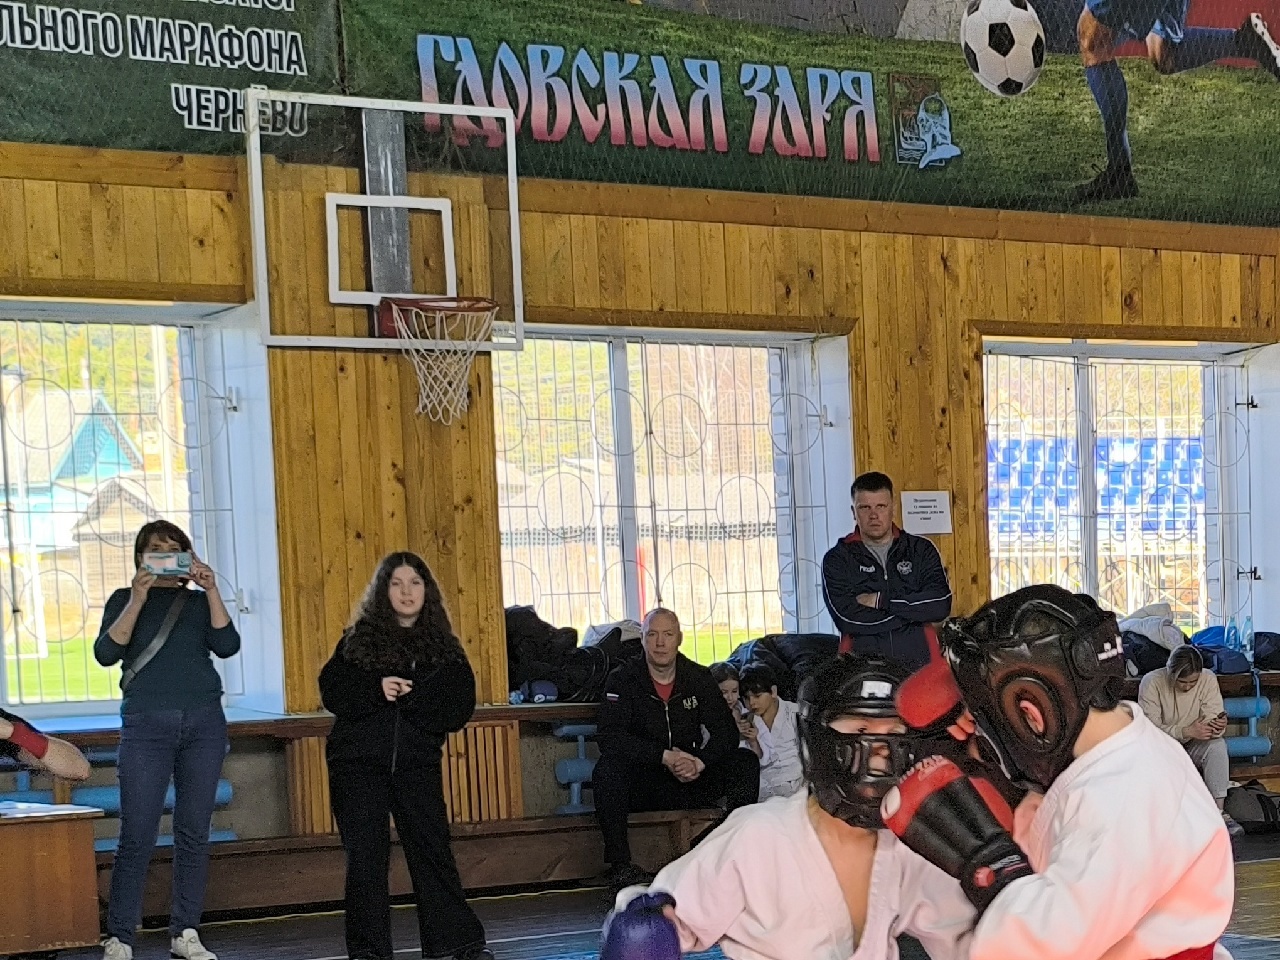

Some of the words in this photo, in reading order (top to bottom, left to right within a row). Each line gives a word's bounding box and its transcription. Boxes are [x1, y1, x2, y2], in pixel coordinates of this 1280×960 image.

[126, 14, 308, 76] МАРАФОНА
[416, 34, 728, 152] ГДОВСКАЯ
[740, 62, 880, 162] ЗАРЯ
